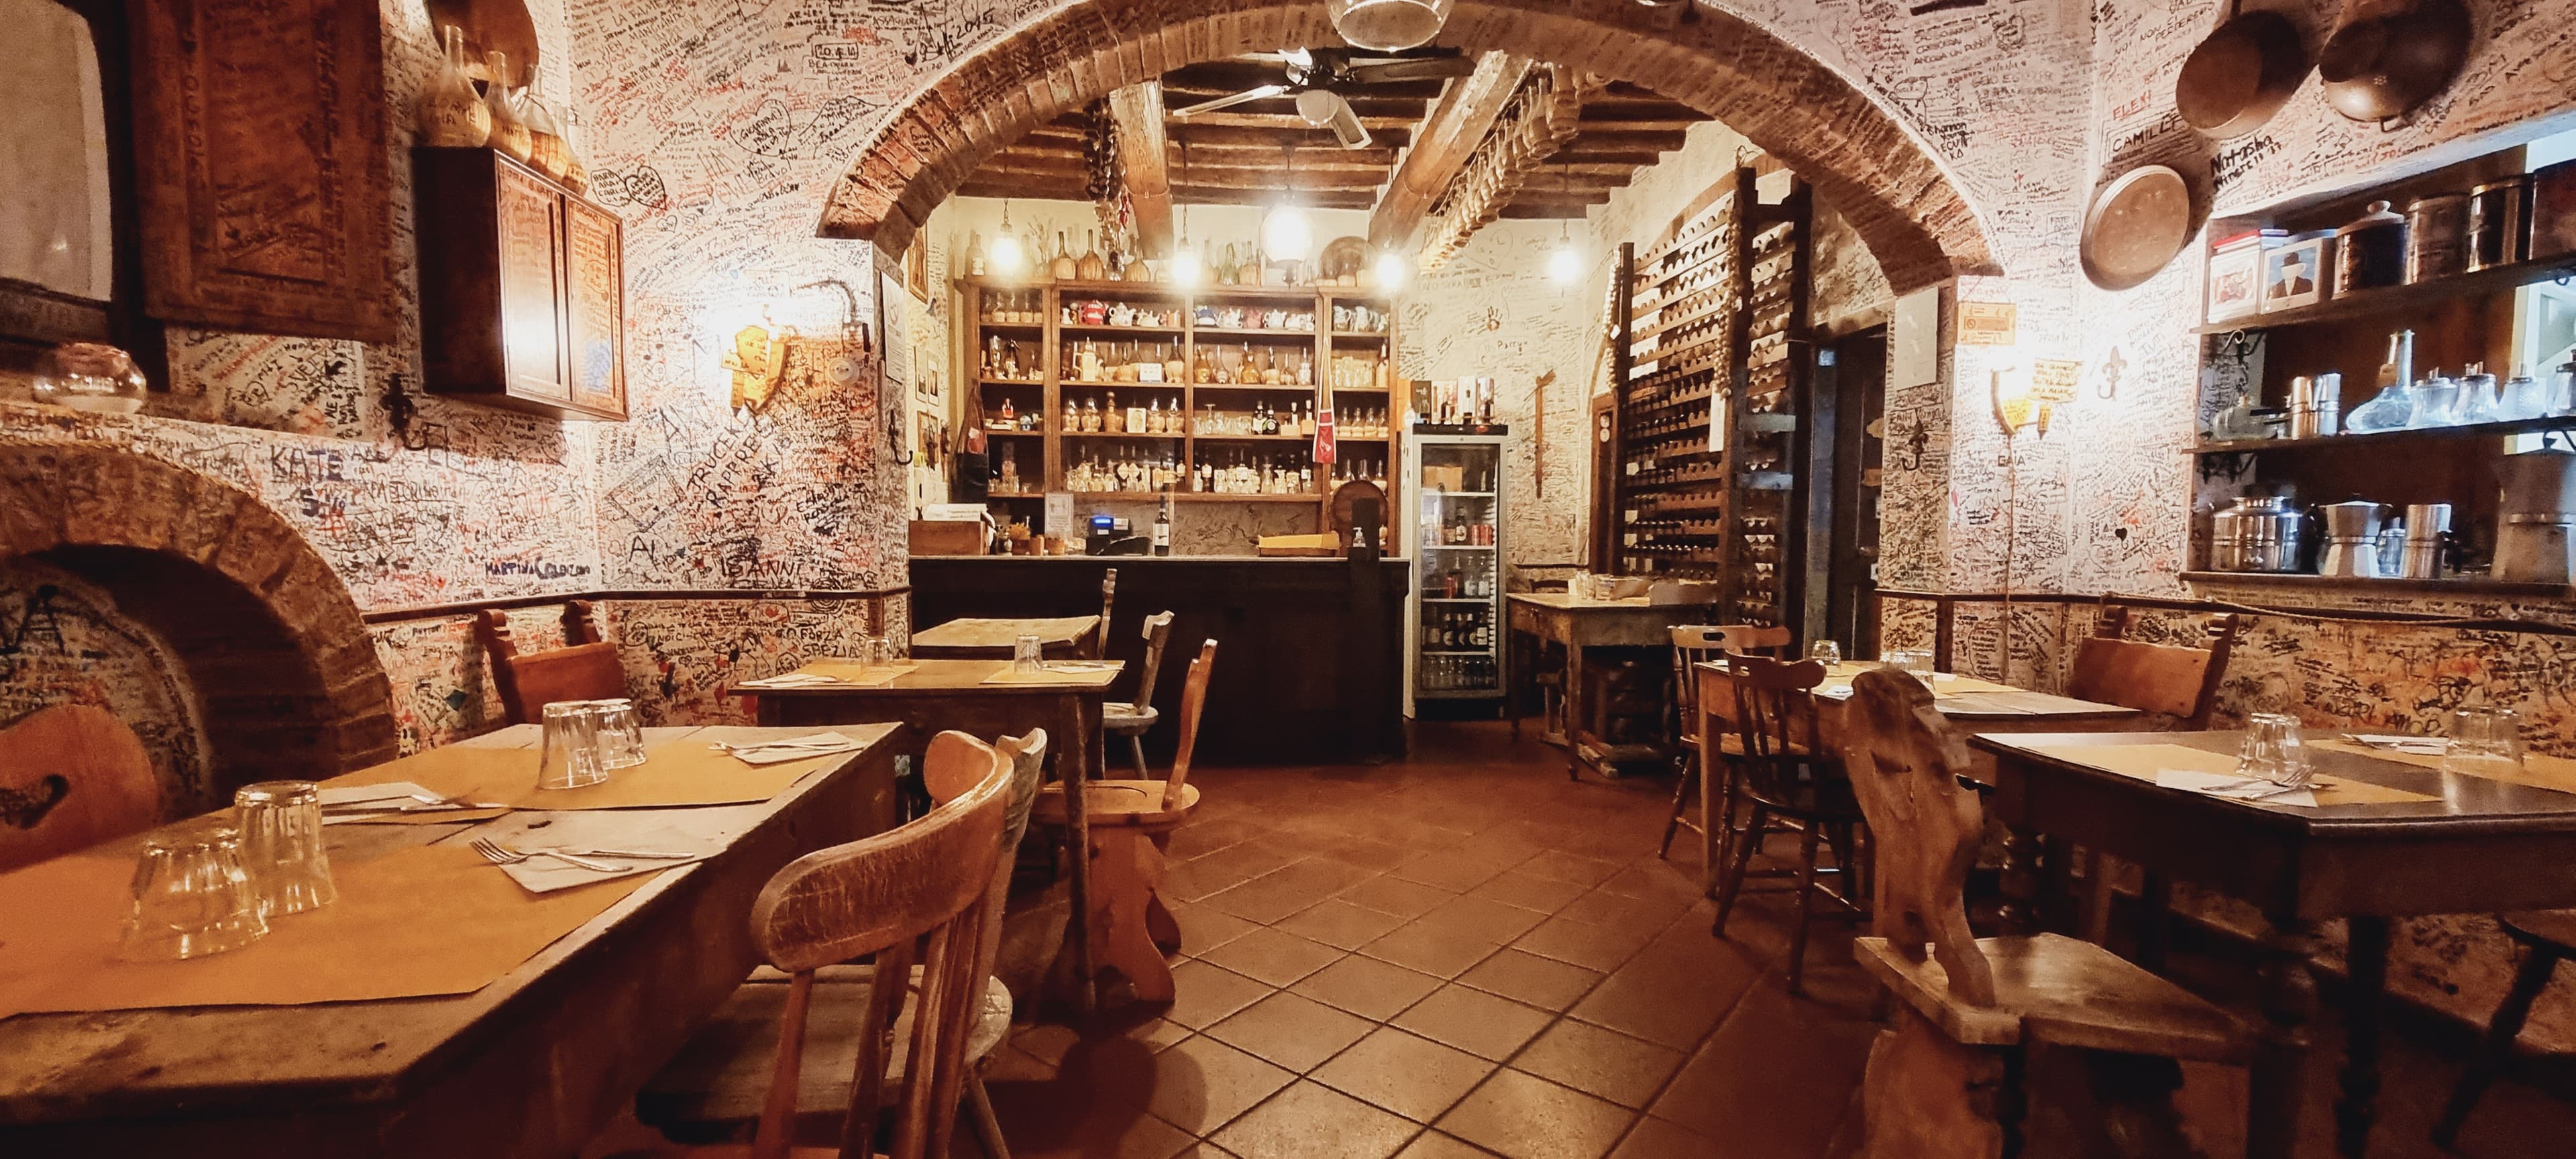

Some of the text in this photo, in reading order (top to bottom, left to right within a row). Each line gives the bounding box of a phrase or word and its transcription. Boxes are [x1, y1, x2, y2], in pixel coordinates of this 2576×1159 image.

[2210, 135, 2274, 178] Natasha
[270, 443, 344, 482] KATE
[484, 561, 535, 577] MARTINA
[800, 626, 844, 641] FORZA
[799, 643, 861, 659] SPEZIA
